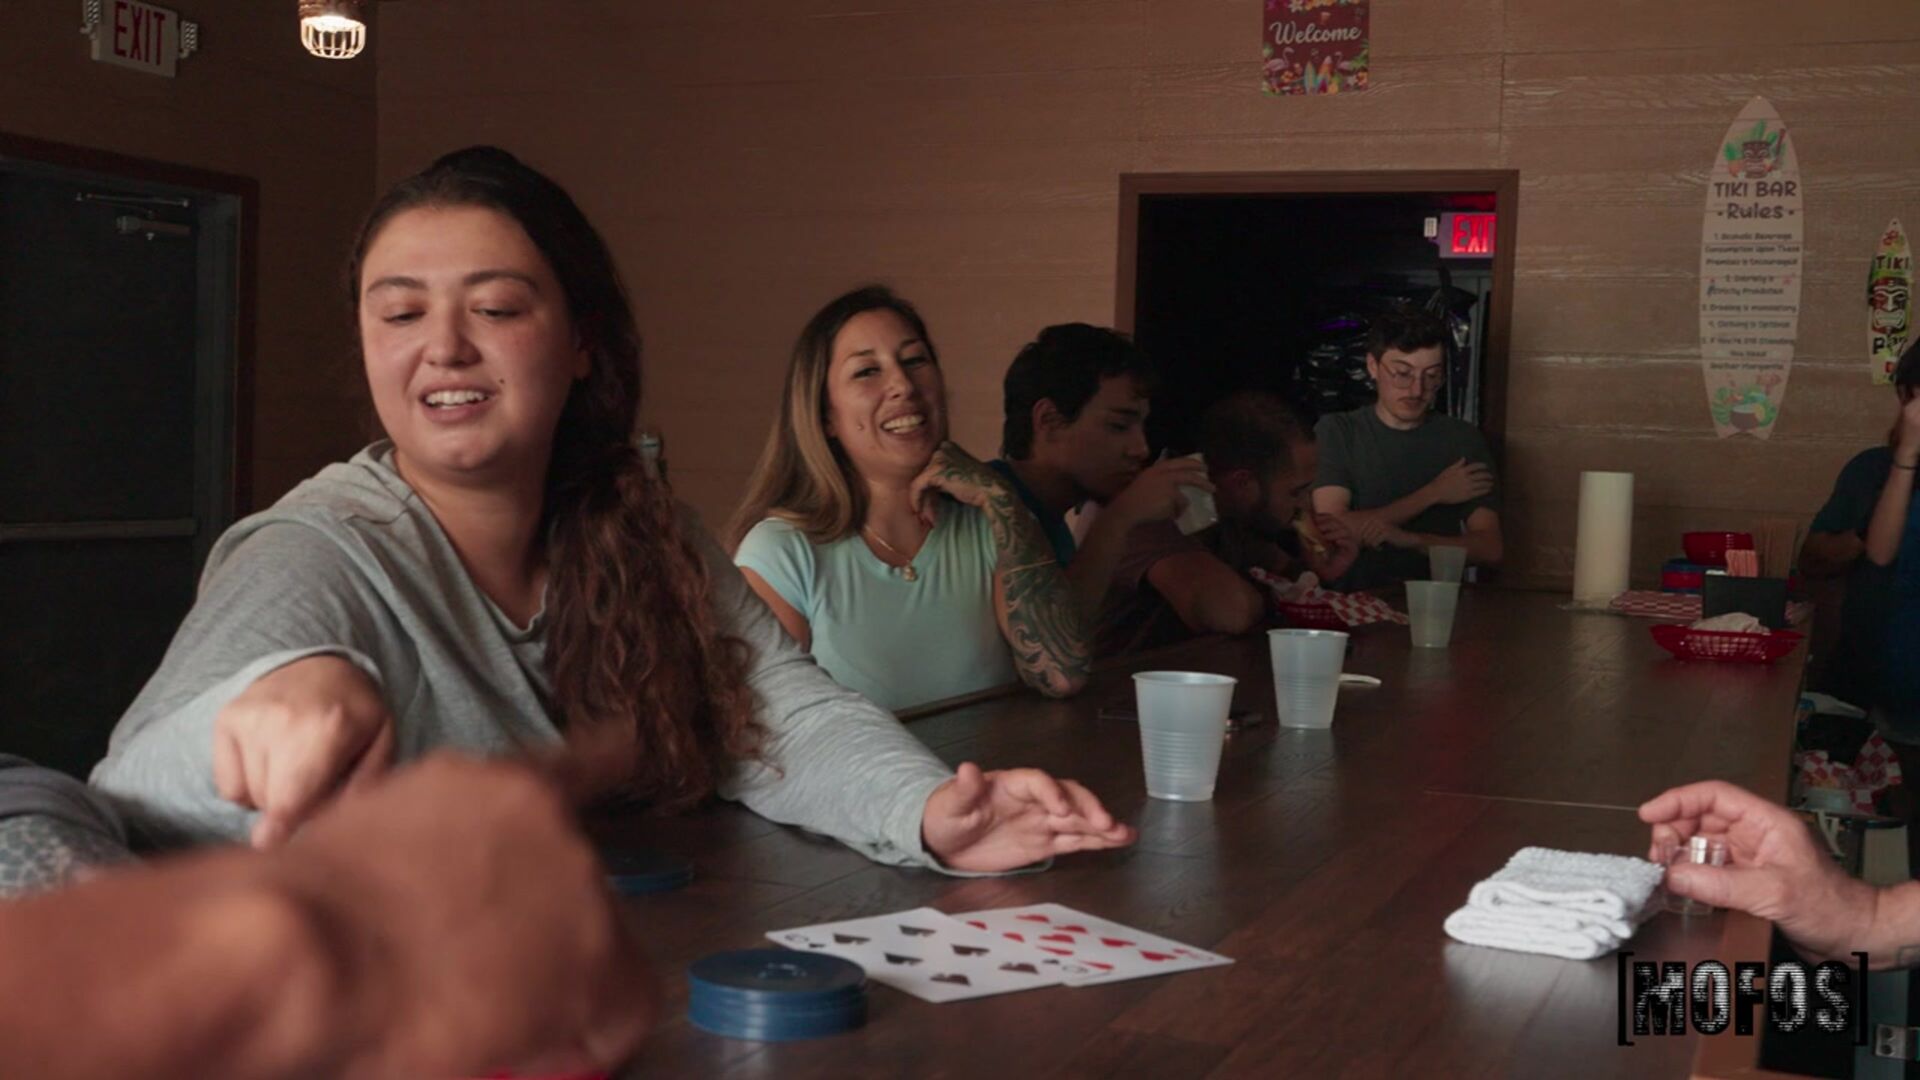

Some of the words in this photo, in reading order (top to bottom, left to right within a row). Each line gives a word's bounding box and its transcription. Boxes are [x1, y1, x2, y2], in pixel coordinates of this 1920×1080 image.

[113, 1, 166, 66] EXIT
[1268, 20, 1363, 45] Welcome
[1714, 181, 1748, 198] TIKI
[1755, 180, 1797, 197] BAR
[1726, 202, 1784, 219] Rules
[1875, 254, 1910, 270] TIKI
